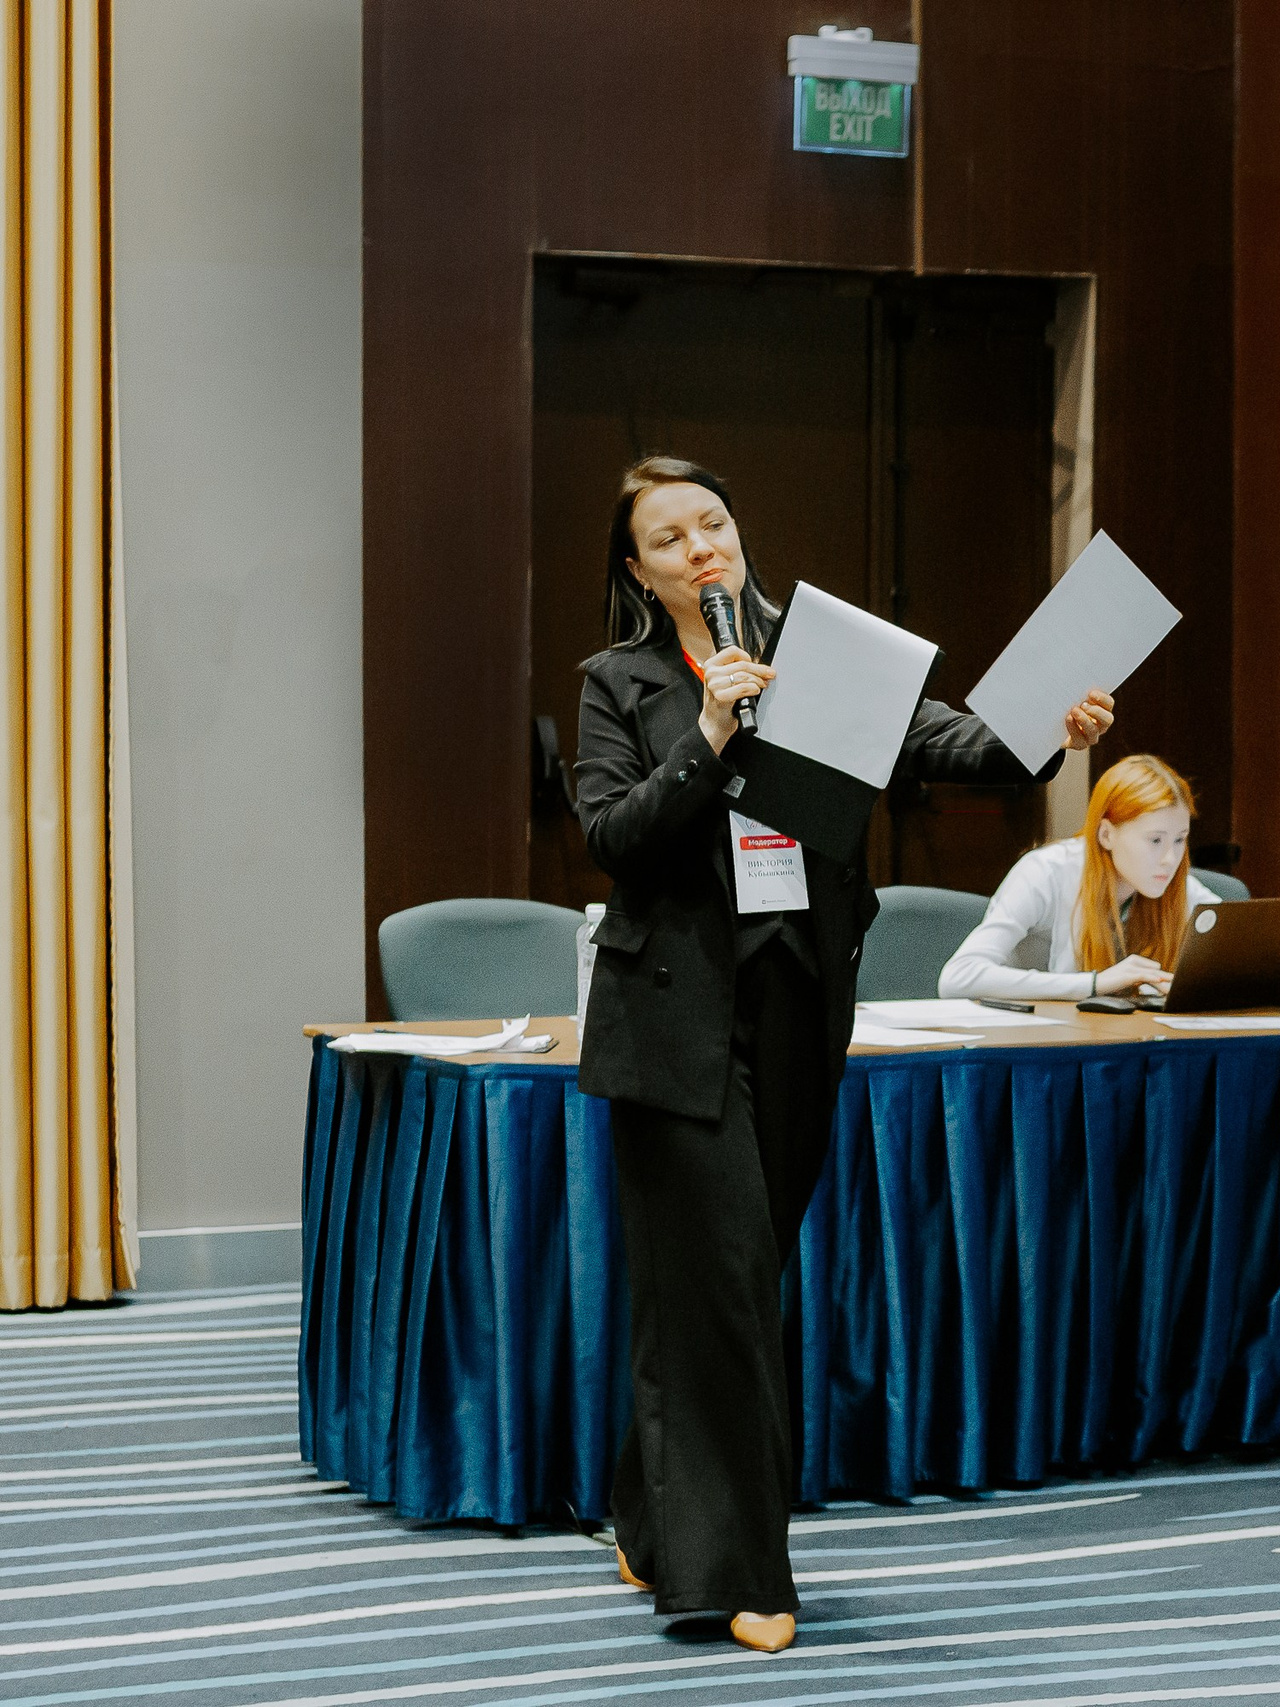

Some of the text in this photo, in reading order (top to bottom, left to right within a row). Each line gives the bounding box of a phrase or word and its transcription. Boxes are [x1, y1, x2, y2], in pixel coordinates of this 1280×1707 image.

[815, 82, 892, 119] ВЫХОД
[829, 112, 877, 143] EXIT
[748, 838, 788, 847] Модератор
[747, 859, 793, 868] ВИКТОРИЯ
